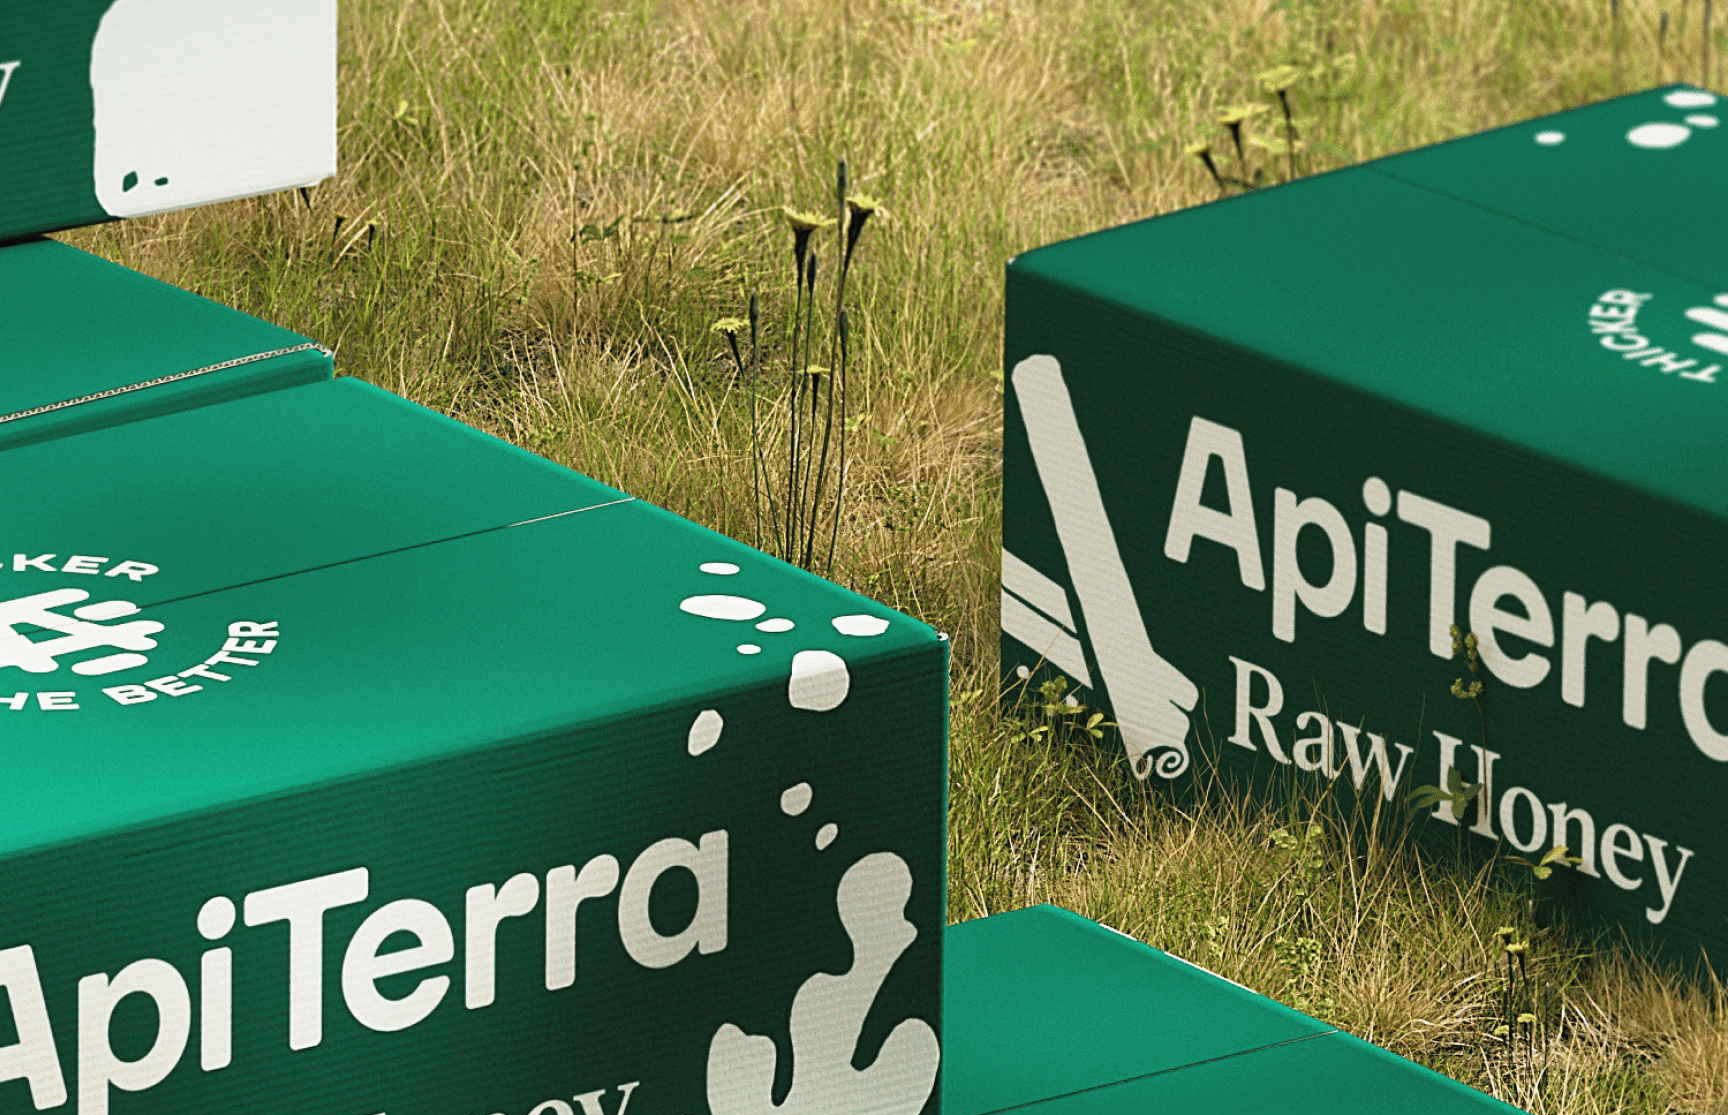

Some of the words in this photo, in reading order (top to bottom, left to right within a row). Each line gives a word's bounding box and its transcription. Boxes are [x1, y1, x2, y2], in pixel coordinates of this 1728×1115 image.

[1588, 287, 1723, 383] THICKER
[101, 621, 279, 706] BETTER
[1227, 655, 1414, 801] Raw
[1431, 730, 1695, 924] Honey
